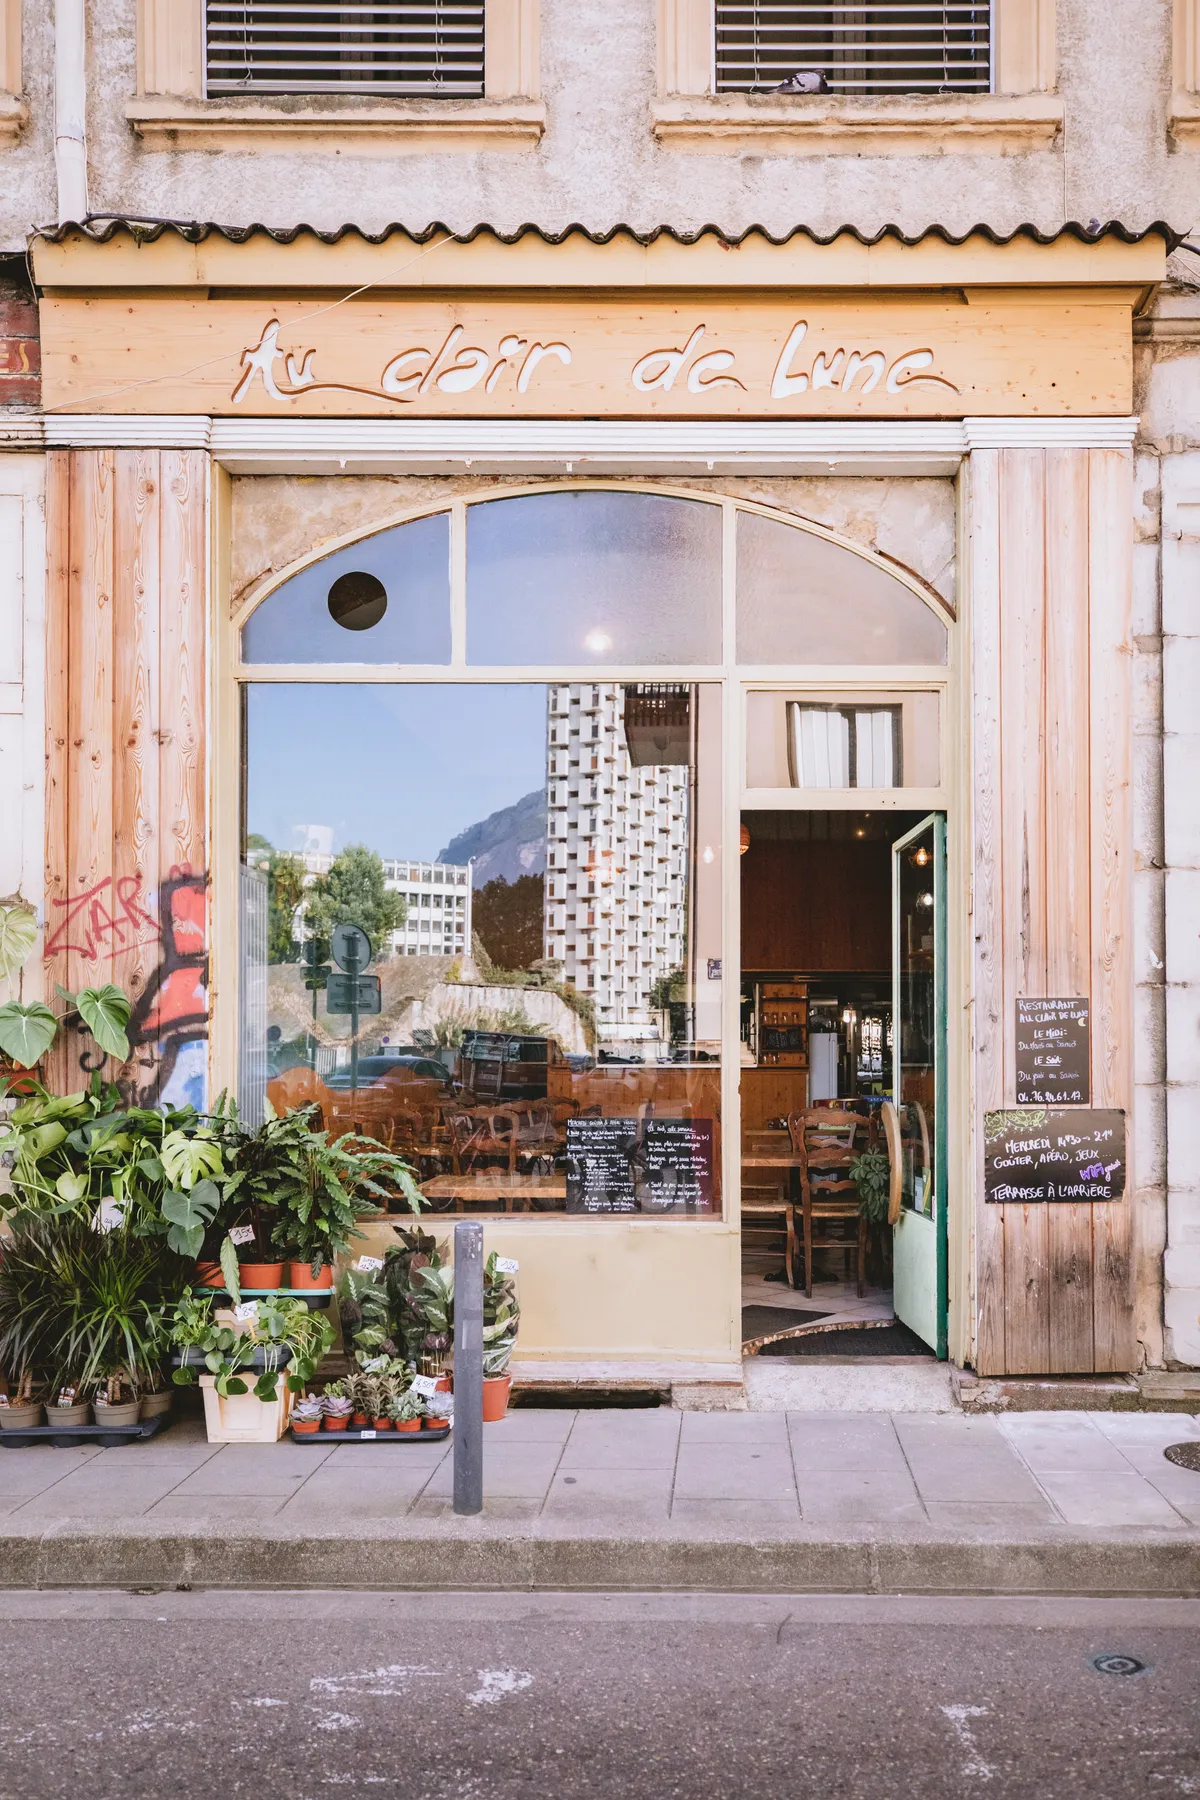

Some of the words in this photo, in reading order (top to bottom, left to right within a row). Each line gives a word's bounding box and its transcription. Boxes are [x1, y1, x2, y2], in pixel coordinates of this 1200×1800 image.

[381, 324, 572, 394] clair
[631, 324, 748, 393] de
[771, 320, 962, 399] Lune
[1018, 1000, 1079, 1012] RESTAURANT
[1019, 1013, 1034, 1023] AU
[1058, 1011, 1069, 1020] DE
[1070, 1010, 1088, 1019] LUNE
[1034, 1029, 1044, 1039] LE
[1018, 1041, 1030, 1051] Du
[1034, 1056, 1043, 1066] LE
[1018, 1071, 1031, 1082] Du
[990, 1183, 1044, 1200] TERRASSE
[1047, 1181, 1056, 1198] À
